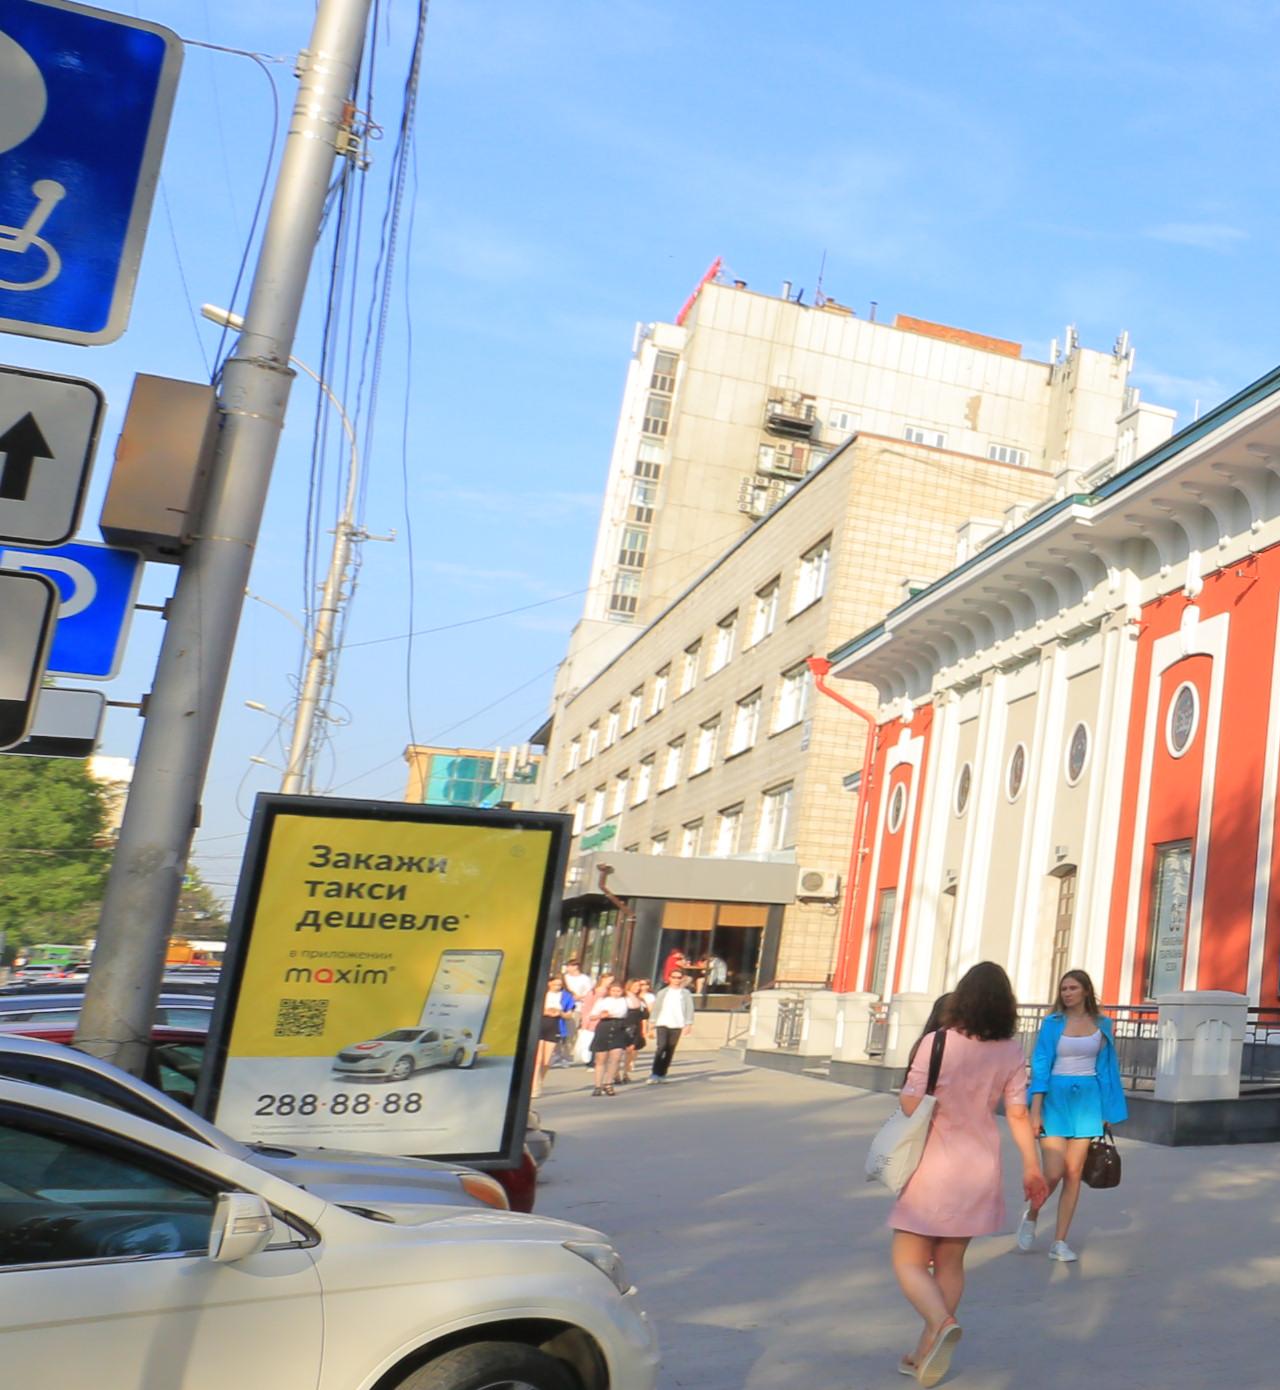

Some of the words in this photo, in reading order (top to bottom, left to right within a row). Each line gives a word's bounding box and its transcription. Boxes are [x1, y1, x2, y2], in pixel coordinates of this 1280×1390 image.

[308, 844, 448, 875] Закажи
[304, 879, 408, 901] такси
[302, 949, 393, 961] приложении
